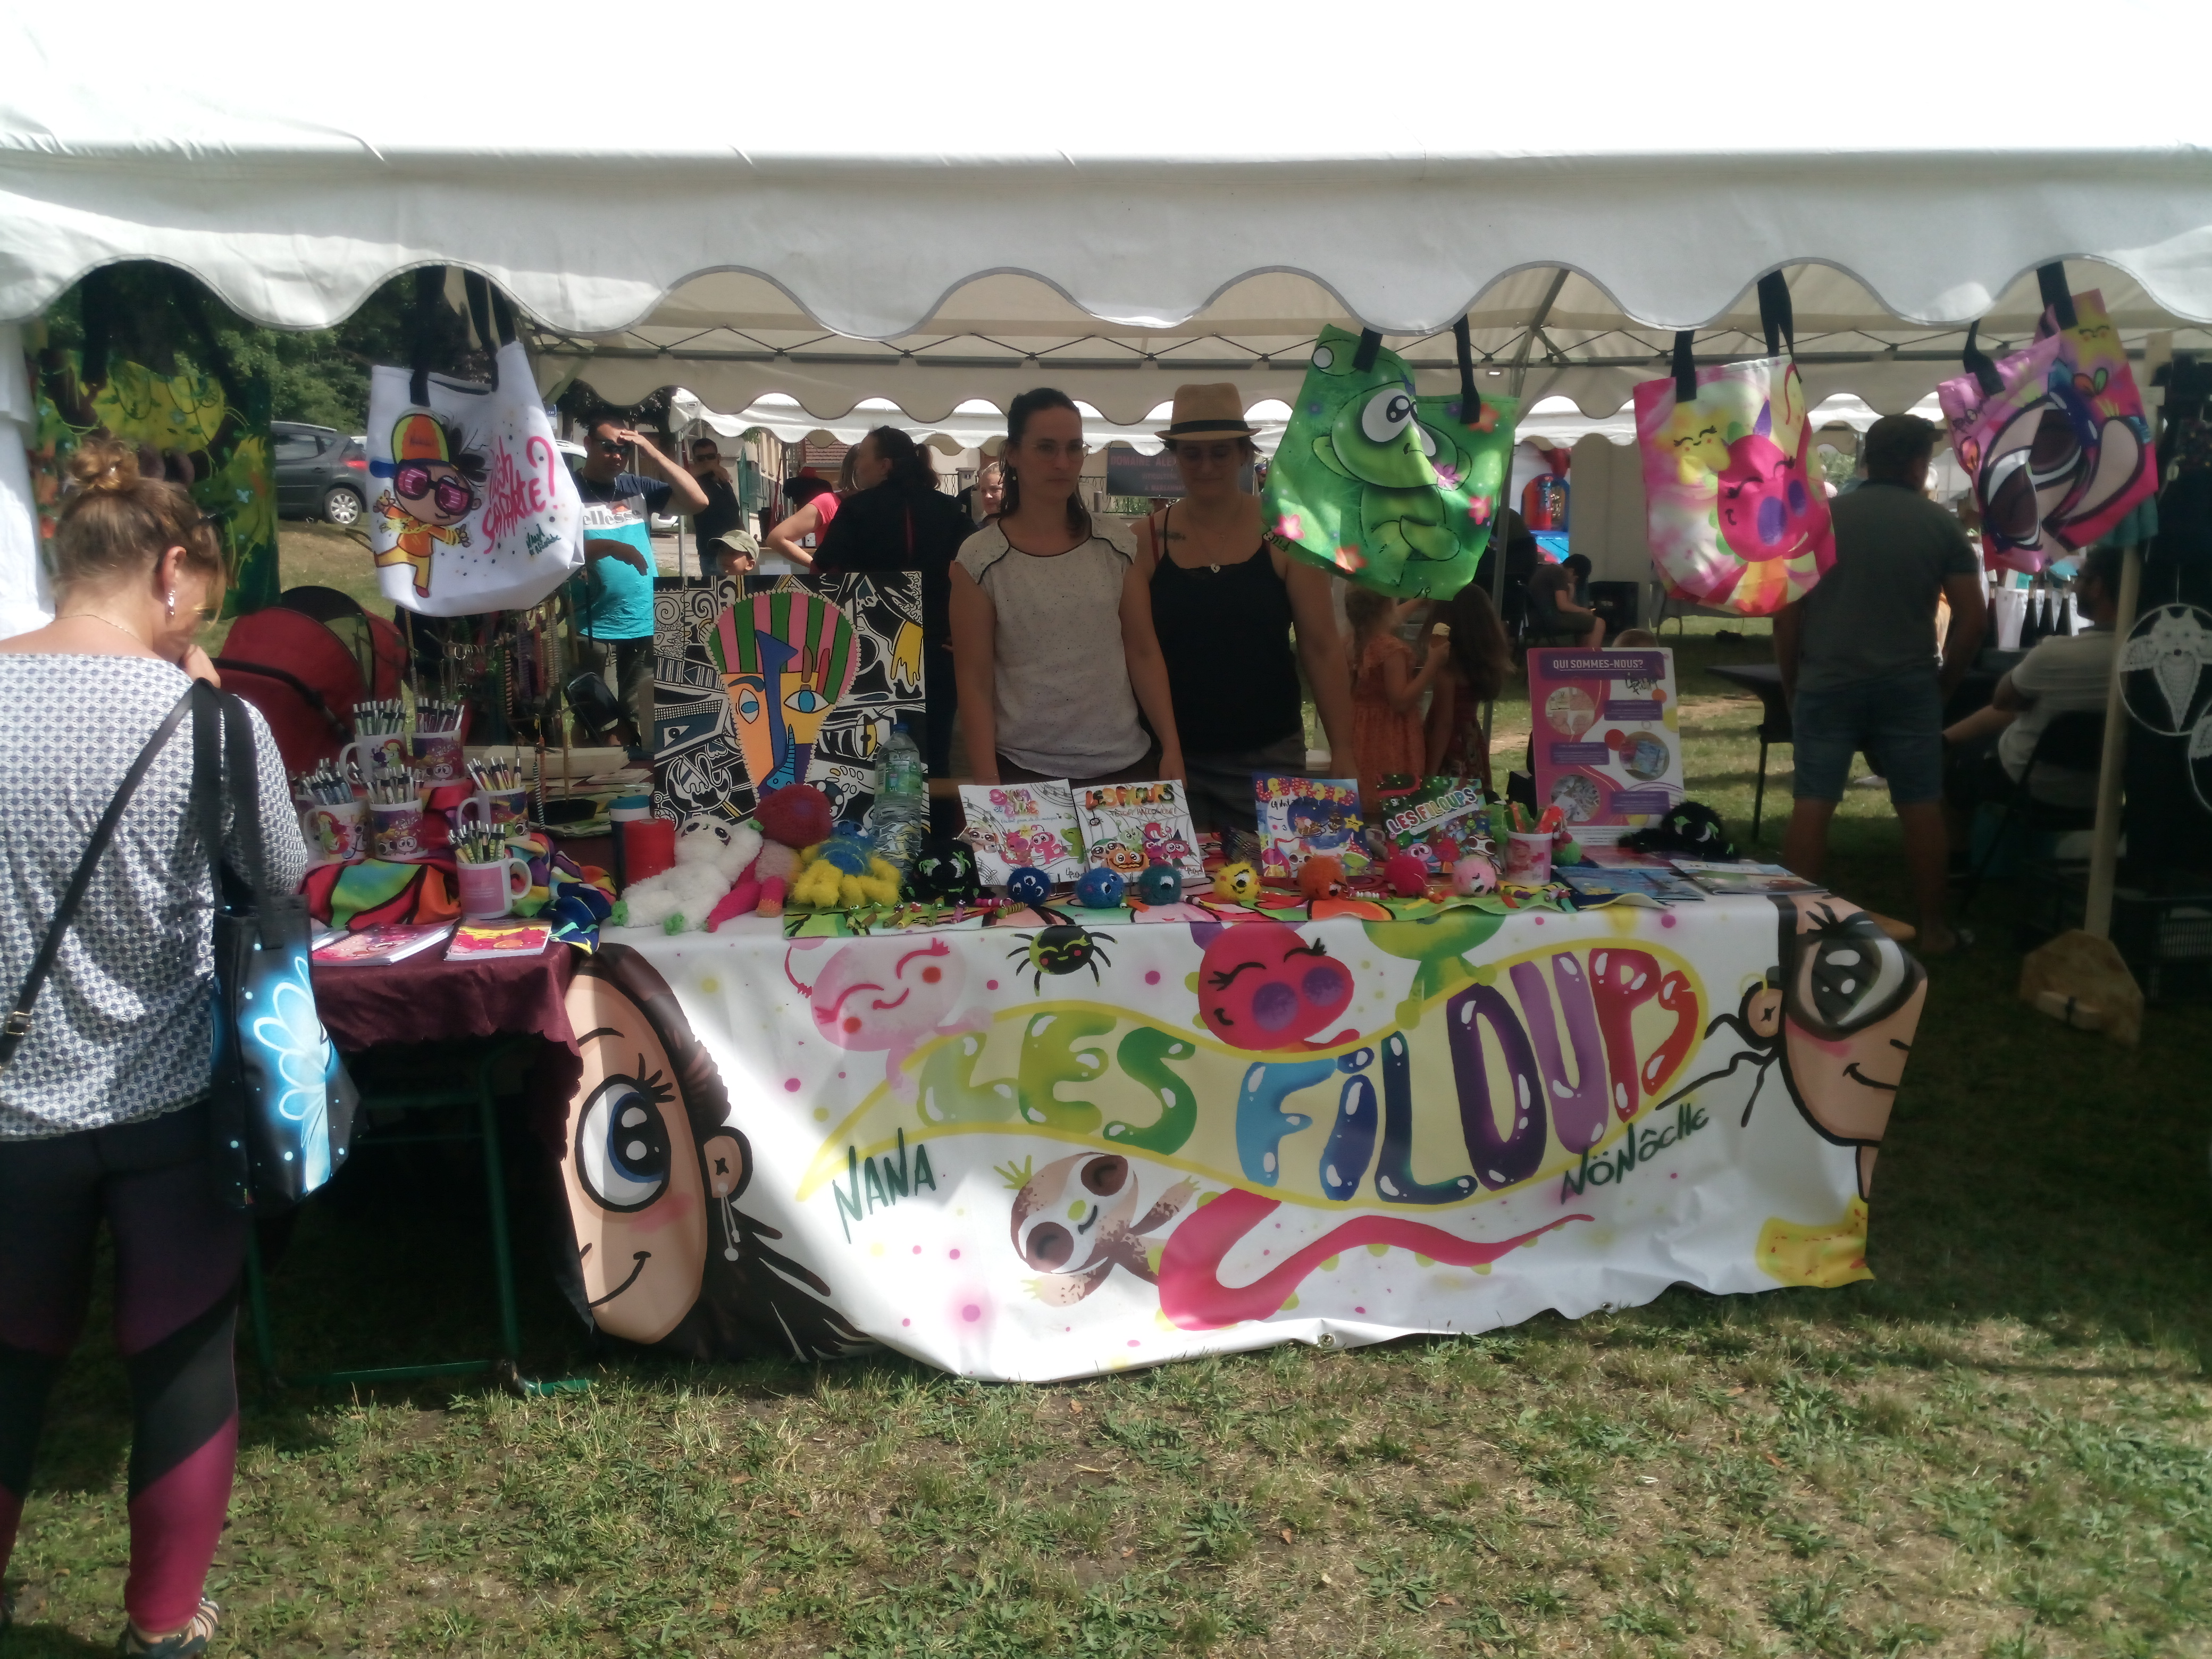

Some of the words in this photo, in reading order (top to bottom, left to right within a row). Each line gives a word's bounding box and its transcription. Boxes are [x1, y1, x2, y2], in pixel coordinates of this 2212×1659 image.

[1110, 455, 1151, 466] DOMAINE
[1553, 659, 1569, 670] QUI
[1570, 659, 1644, 669] SOMMES-NOUS?
[1386, 810, 1420, 835] LES
[1415, 787, 1477, 822] FILOUPS
[916, 1011, 1197, 1156] LES
[832, 1127, 936, 1244] NANA
